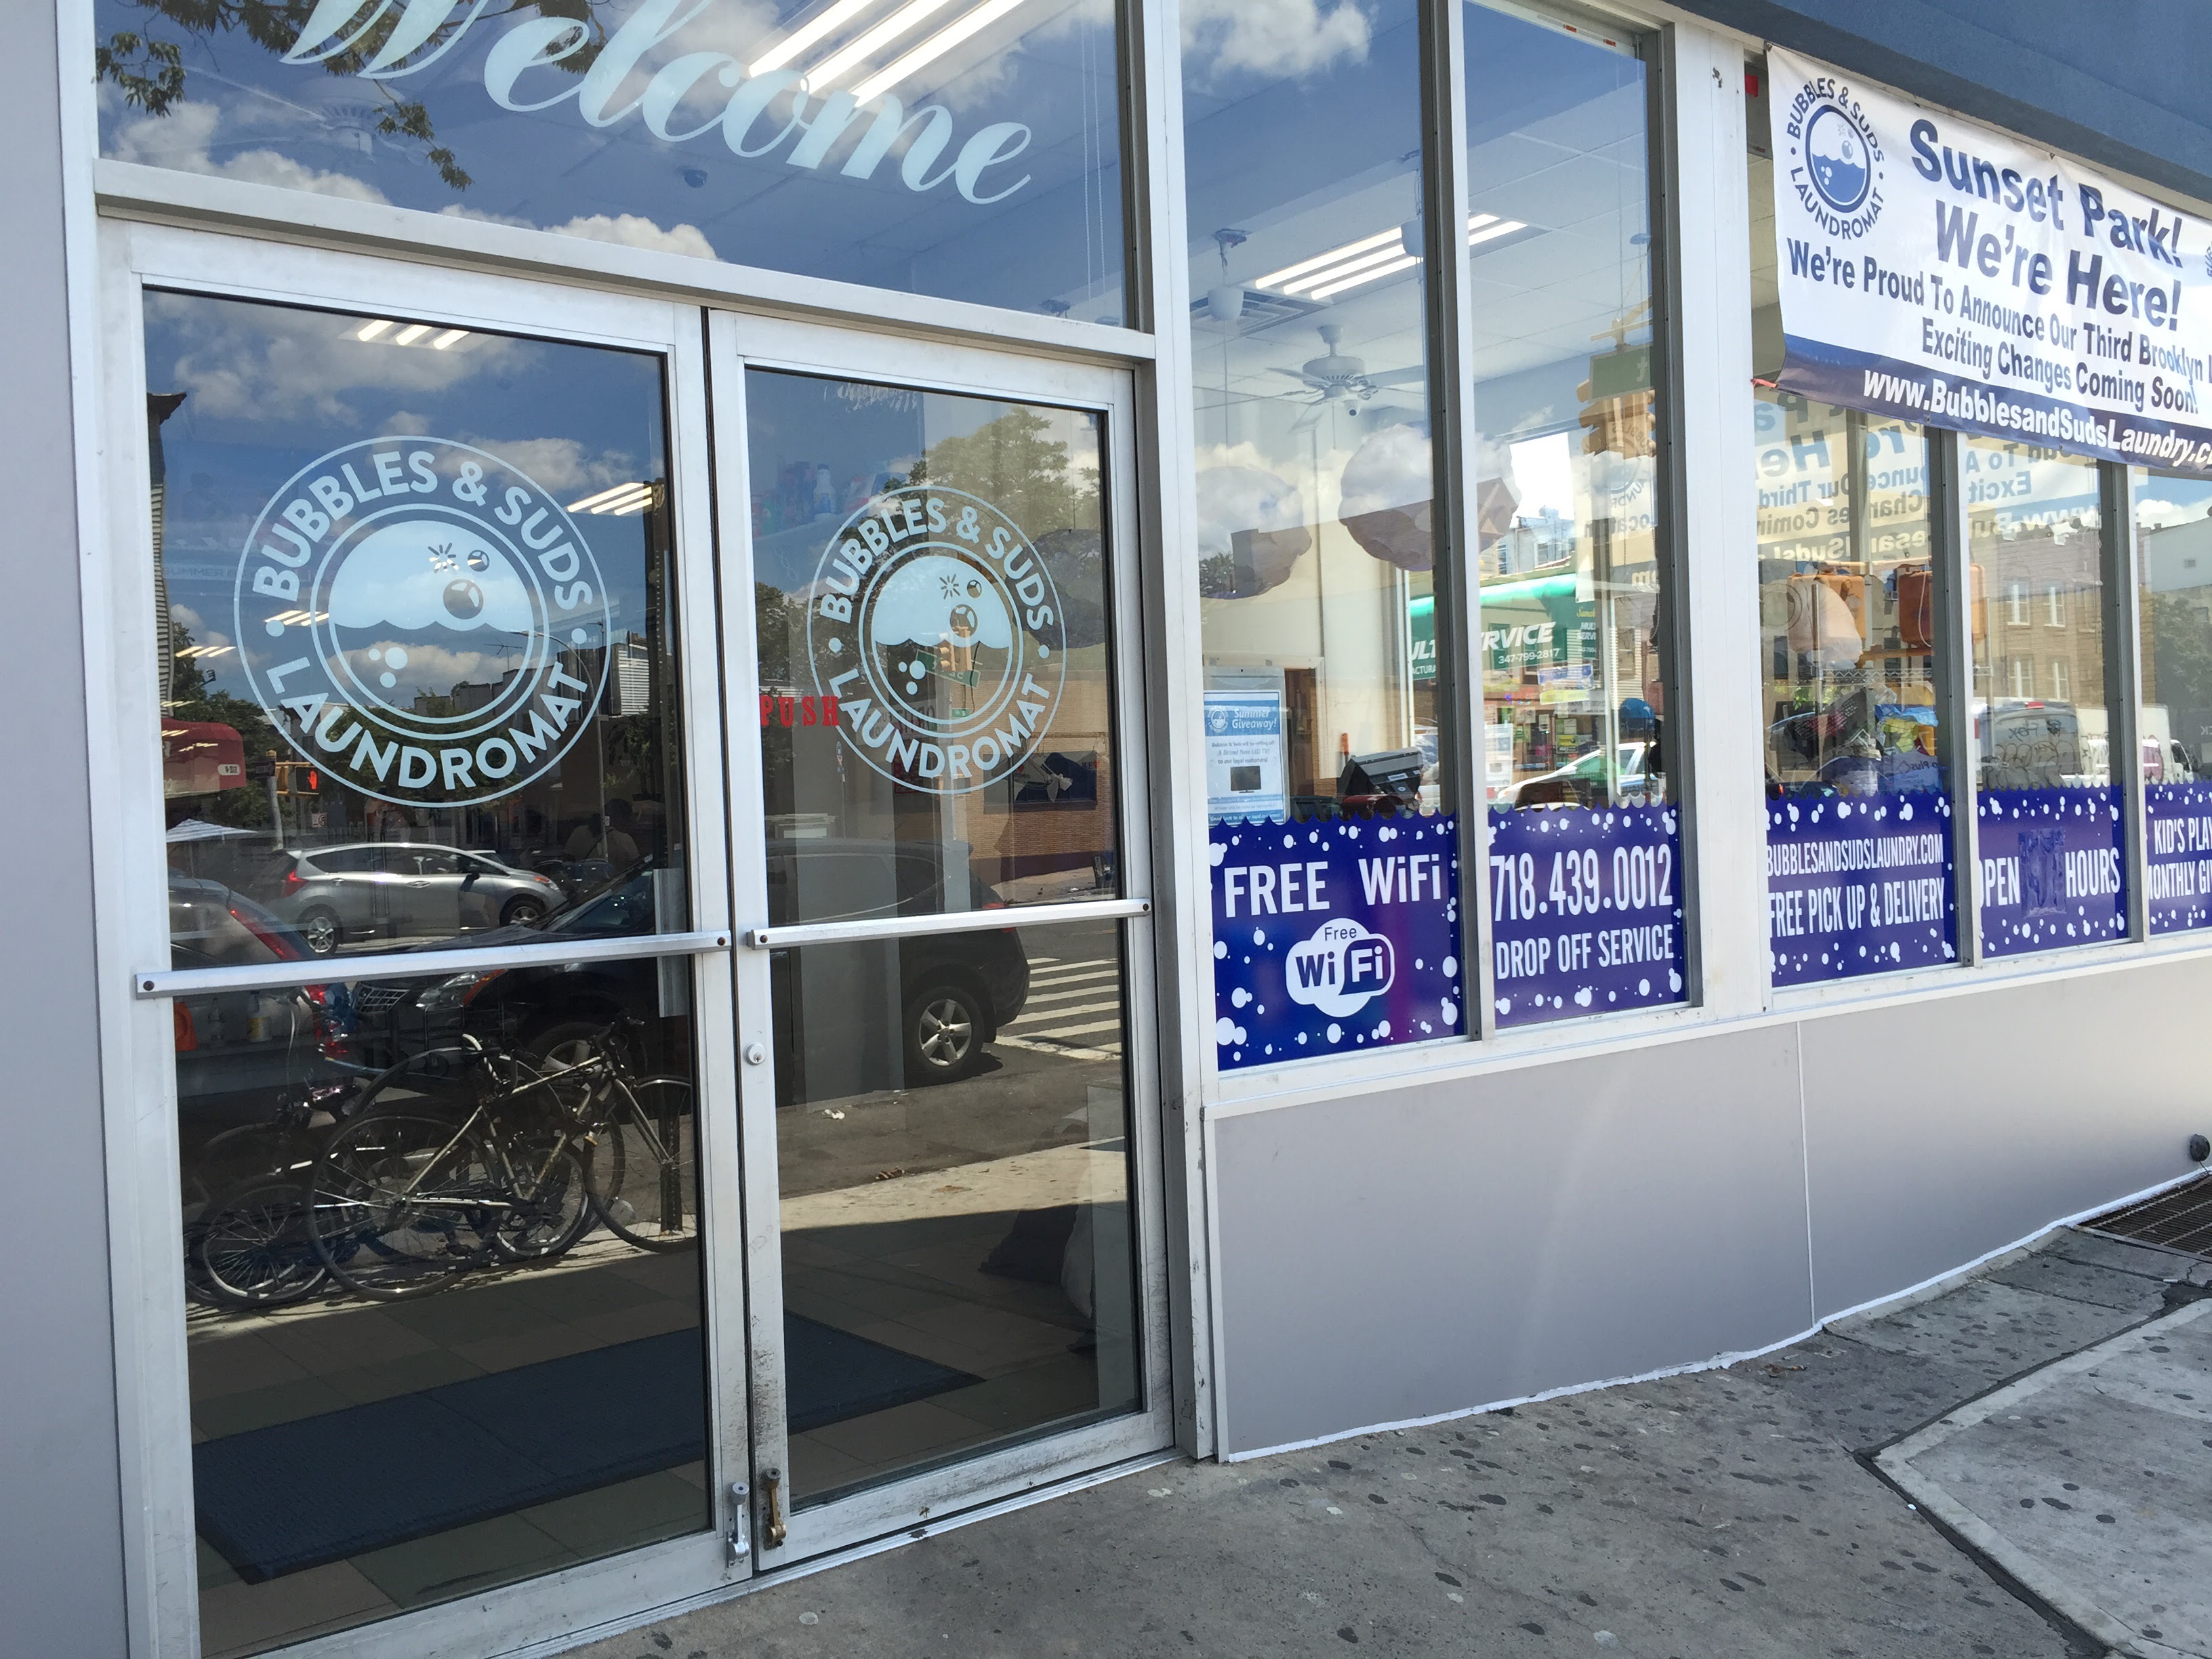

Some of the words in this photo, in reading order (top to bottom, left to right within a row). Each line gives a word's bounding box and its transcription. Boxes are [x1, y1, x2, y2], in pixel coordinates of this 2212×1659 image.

[1786, 77, 1836, 140] BUBBLES
[1837, 86, 1849, 109] &
[1850, 102, 1885, 163] SUDS
[1790, 166, 1884, 240] LAUNDROMAT
[1910, 119, 2065, 231] Sunset
[2078, 184, 2184, 269] Park!
[1935, 199, 2053, 295] We're
[2066, 249, 2182, 331] Here!
[1786, 237, 1856, 289] We're
[1863, 255, 1925, 307] Proud
[1930, 270, 1954, 314] To
[1960, 285, 2045, 341] Announce
[2049, 313, 2077, 351] Our
[2082, 321, 2132, 363] Third
[2139, 334, 2203, 384] Brooklyn
[1922, 317, 1992, 380] Exciting
[1998, 340, 2072, 395] Changes
[2076, 361, 2146, 413] Coming
[2151, 376, 2199, 415] Soon!
[252, 451, 438, 602] BUBBLES
[451, 461, 488, 507] &
[494, 486, 594, 611] SUDS
[819, 497, 947, 623] BUBBLES
[956, 506, 981, 544] &
[985, 526, 1054, 630] SUDS
[1481, 621, 1557, 651] RVICE
[266, 657, 589, 791] LAUNDROMAT
[759, 695, 840, 726] PUSH
[829, 668, 1050, 779] LAUNDROMAT
[1231, 718, 1277, 731] Giveaway!
[1234, 708, 1270, 718] Summer
[1767, 834, 1944, 877] BUBBLESANDSUDSLAUNDRY.COM
[2154, 817, 2186, 855] KID'S
[1223, 861, 1330, 918] FREE
[1358, 853, 1441, 905] WiFi
[1489, 844, 1673, 922] 718.439.0012
[1768, 890, 1805, 938] FREE
[1808, 886, 1843, 934] PICK
[1846, 884, 1866, 930] UP
[1870, 882, 1881, 928] &
[1884, 877, 1945, 926] DELIVERY
[2065, 847, 2121, 899] HOURS
[1324, 926, 1357, 941] Free
[1496, 937, 1551, 980] DROP
[1557, 932, 1592, 974] OFF
[1597, 924, 1674, 968] SERVICE
